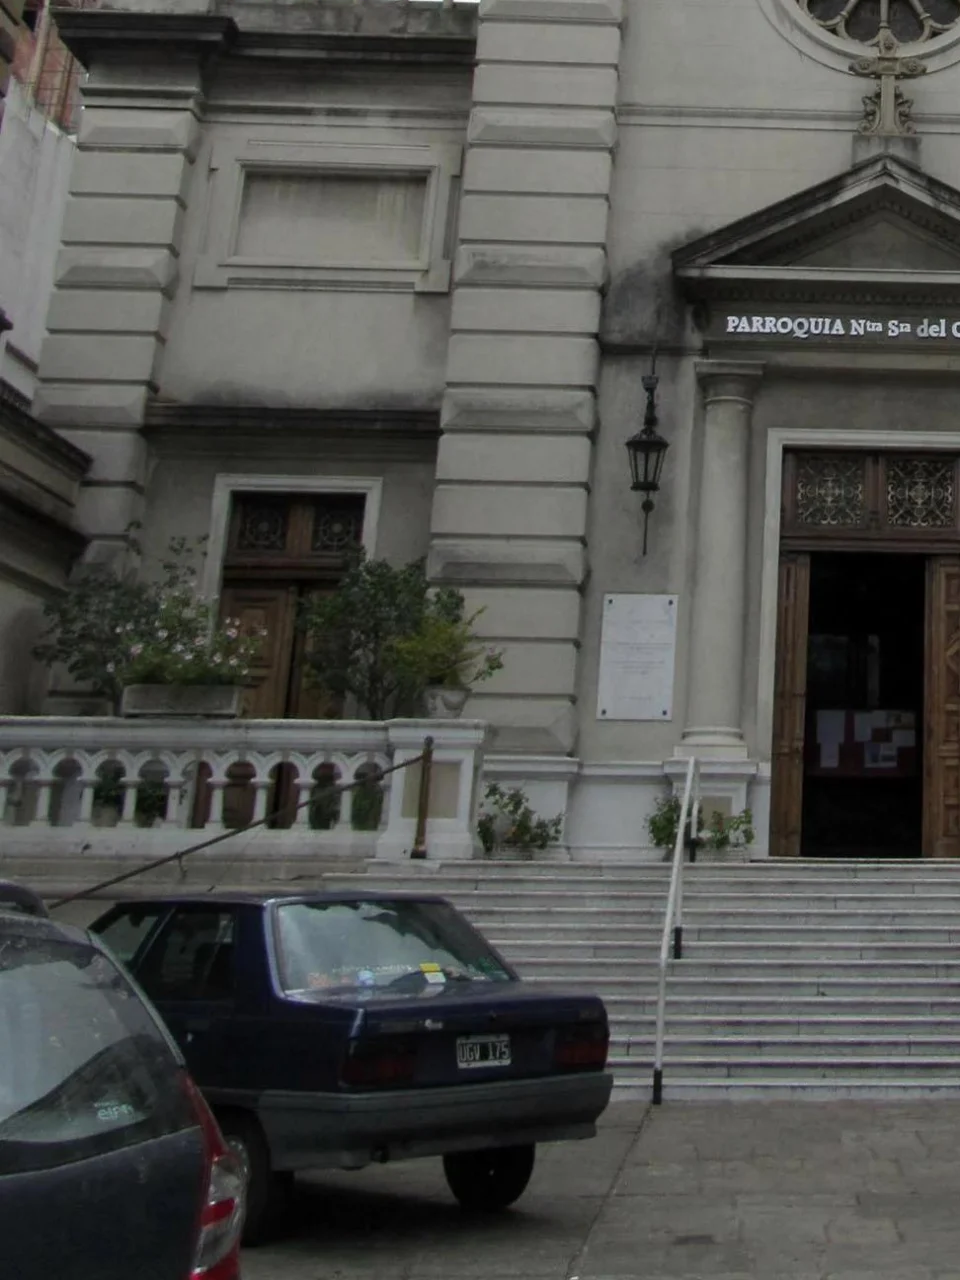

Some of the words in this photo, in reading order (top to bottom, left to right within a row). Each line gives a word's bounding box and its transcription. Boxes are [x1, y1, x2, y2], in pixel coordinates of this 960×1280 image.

[726, 316, 844, 338] PARROQUIA
[916, 319, 946, 337] del
[488, 1042, 509, 1059] 175
